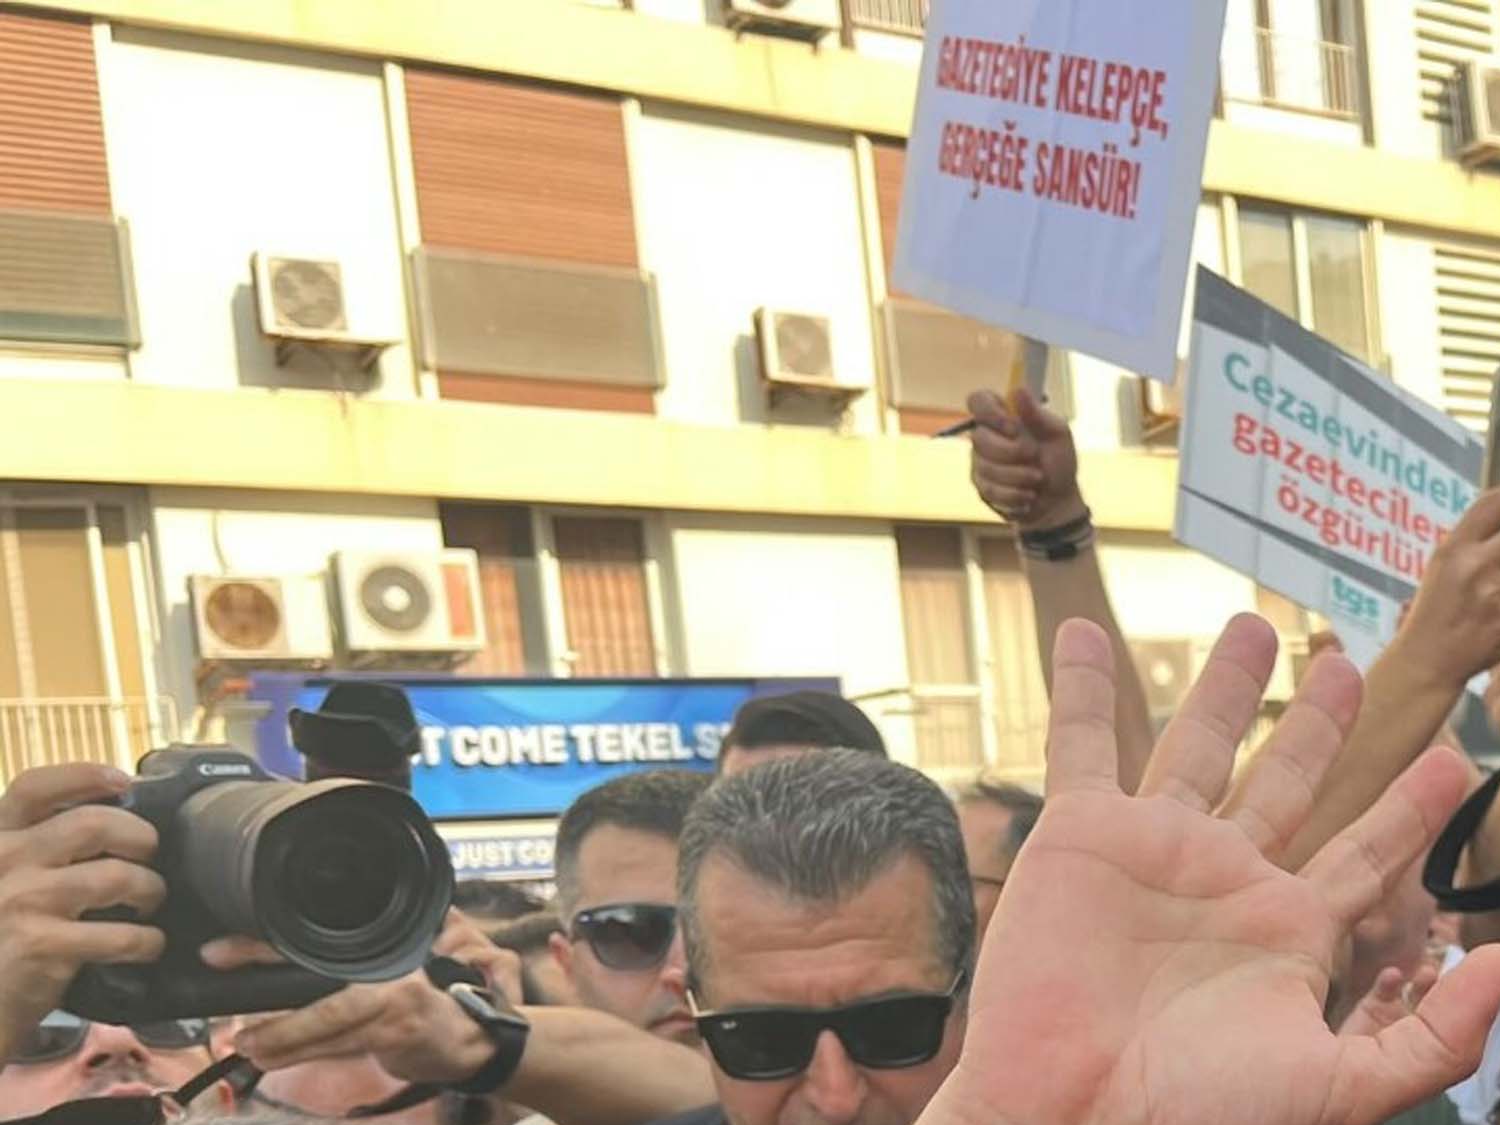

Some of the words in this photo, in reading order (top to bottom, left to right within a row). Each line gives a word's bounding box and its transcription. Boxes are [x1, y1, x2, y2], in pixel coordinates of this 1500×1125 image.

[1056, 53, 1168, 147] KELEPÇE,
[1033, 141, 1142, 220] SANSÜR!
[452, 724, 569, 766] COME
[570, 722, 694, 763] TEKEL
